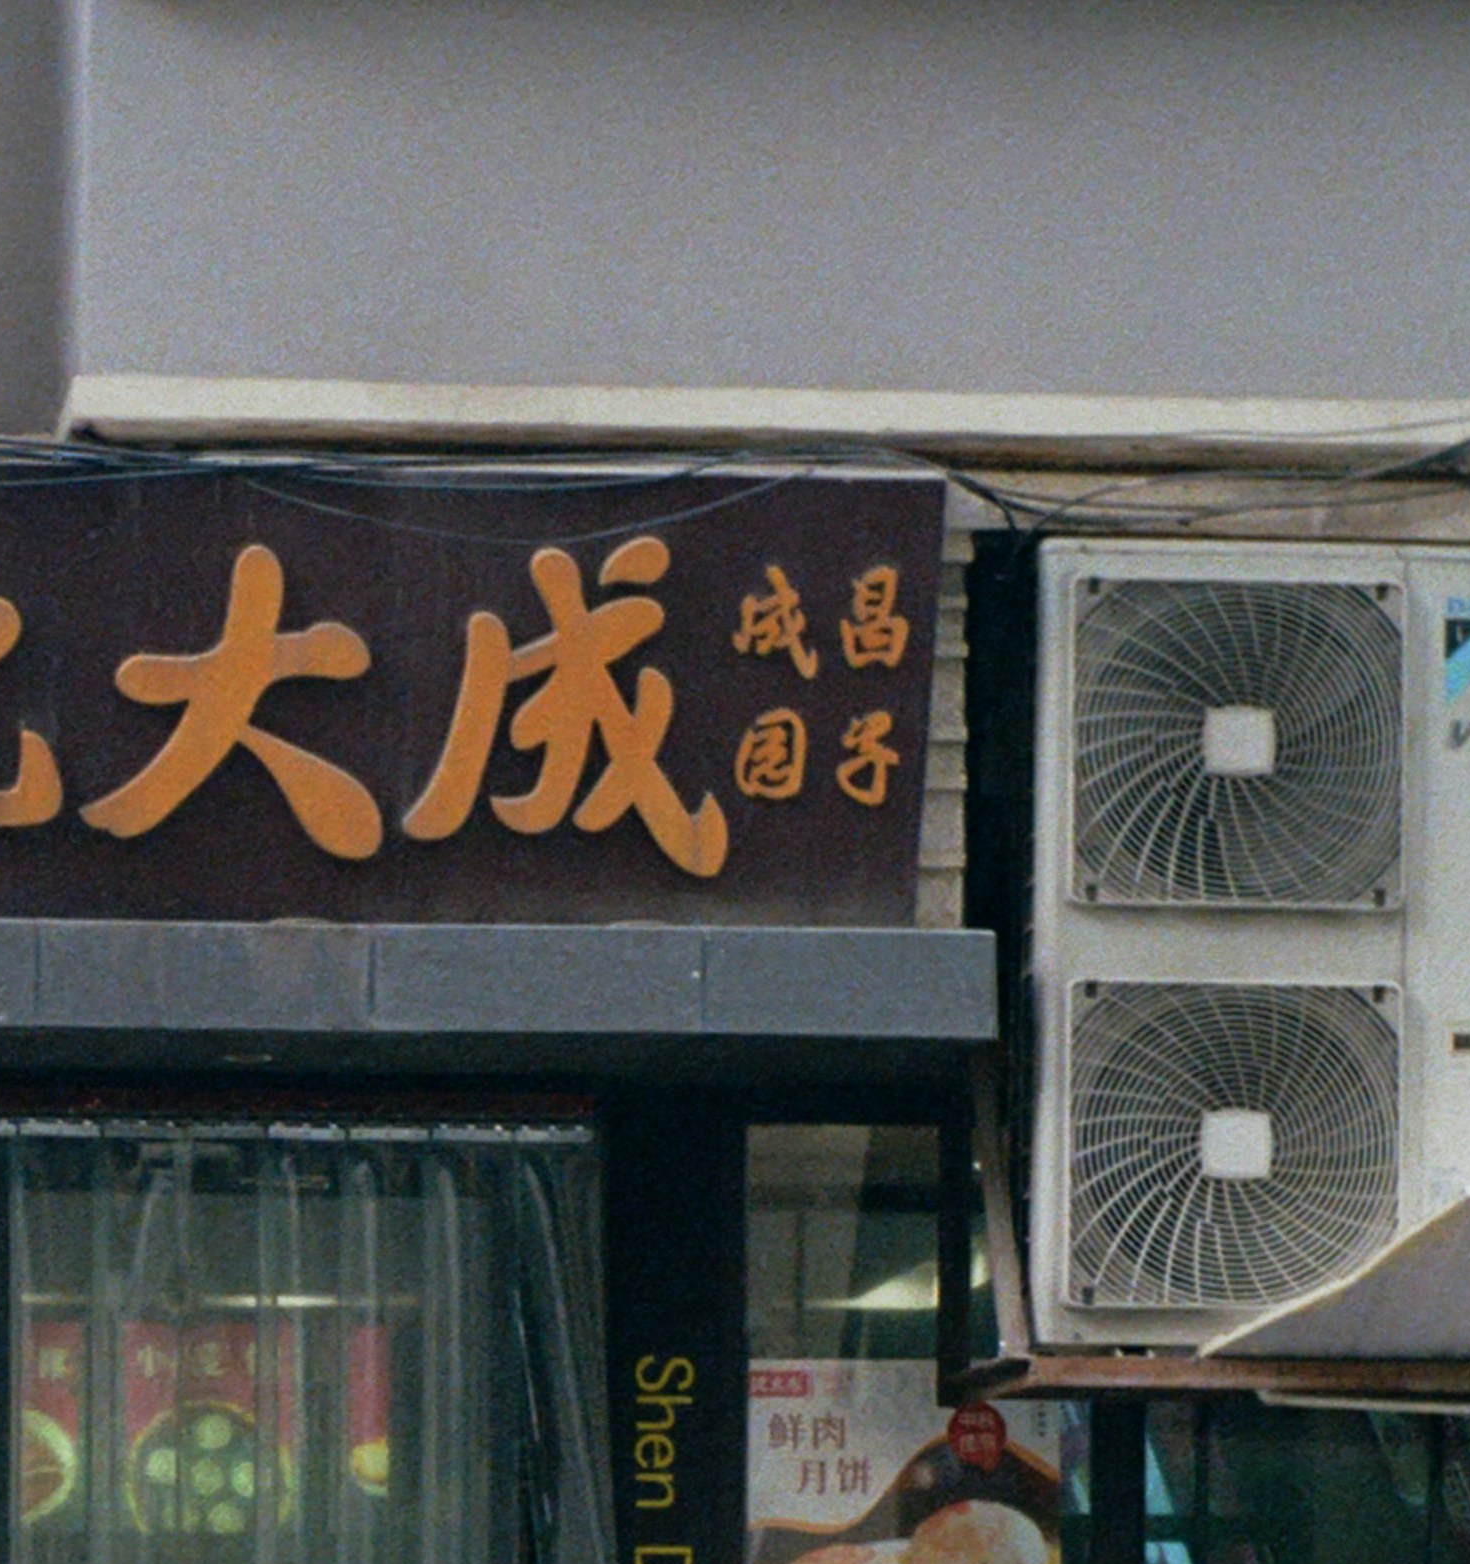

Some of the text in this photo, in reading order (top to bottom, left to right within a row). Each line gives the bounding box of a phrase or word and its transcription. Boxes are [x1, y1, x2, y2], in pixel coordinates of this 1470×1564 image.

[635, 1357, 694, 1508] Shen
[768, 1411, 846, 1451] 鲜肉
[796, 1457, 872, 1495] 月饼
